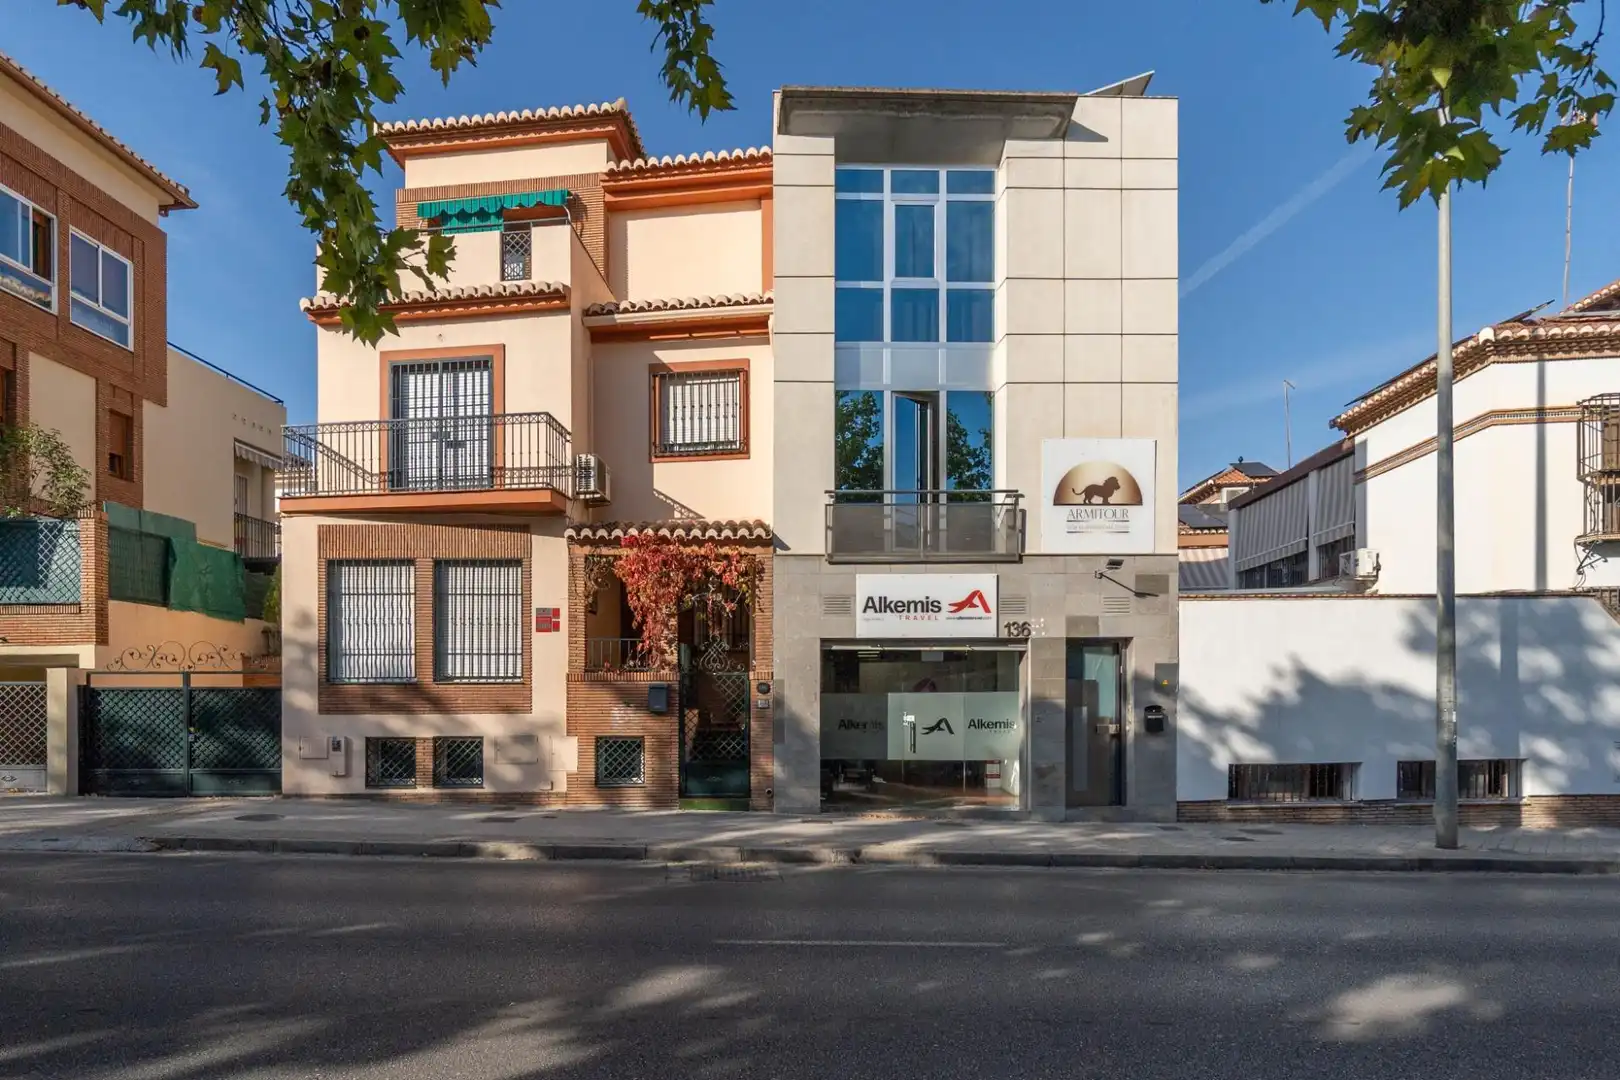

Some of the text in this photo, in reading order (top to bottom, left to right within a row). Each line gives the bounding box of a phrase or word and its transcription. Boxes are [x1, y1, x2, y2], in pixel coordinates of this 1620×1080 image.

[1066, 508, 1130, 520] ARMITOUR
[862, 596, 942, 614] Alkemis
[1003, 621, 1032, 638] 136
[967, 718, 1016, 730] Alkemis
